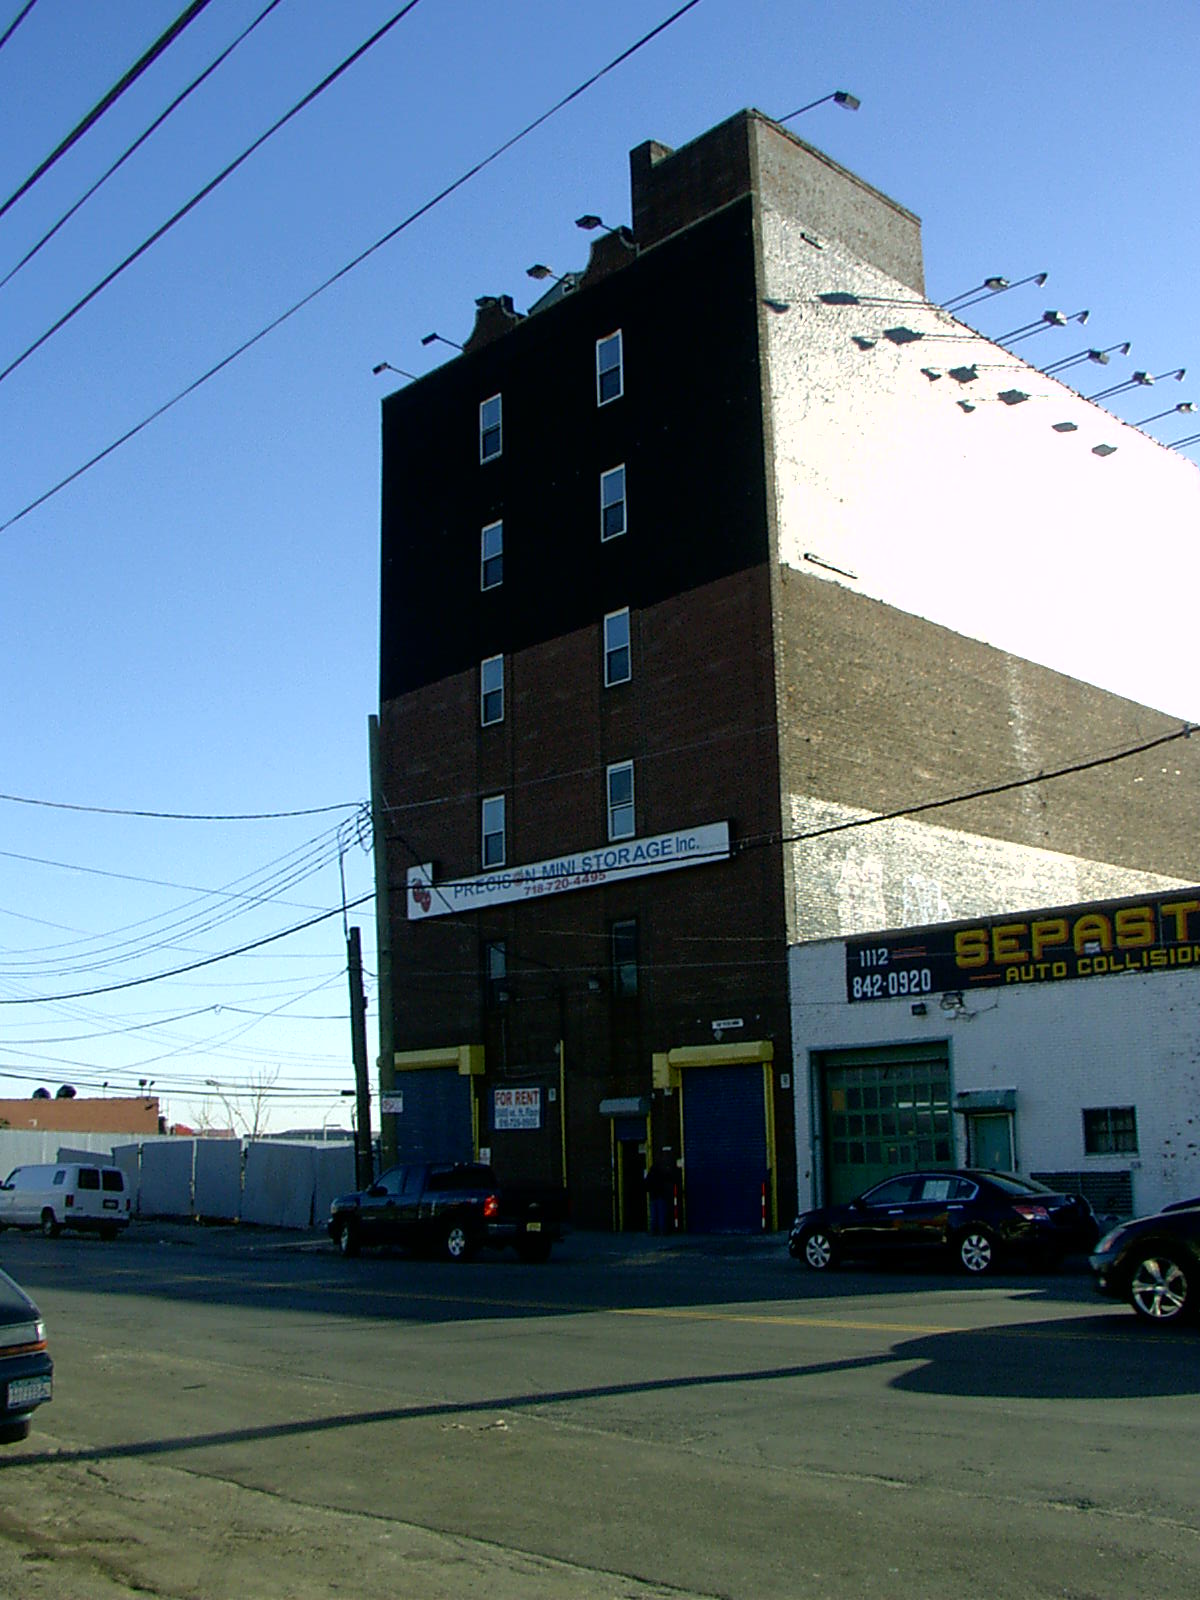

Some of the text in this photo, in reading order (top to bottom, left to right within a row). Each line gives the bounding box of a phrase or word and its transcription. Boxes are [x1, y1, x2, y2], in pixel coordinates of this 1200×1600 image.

[543, 859, 576, 878] MINI
[581, 838, 673, 872] STORAGE
[675, 835, 700, 853] Inc.
[860, 948, 889, 967] 1112
[1005, 961, 1068, 983] AUTO
[495, 1090, 539, 1106] FOR RENT
